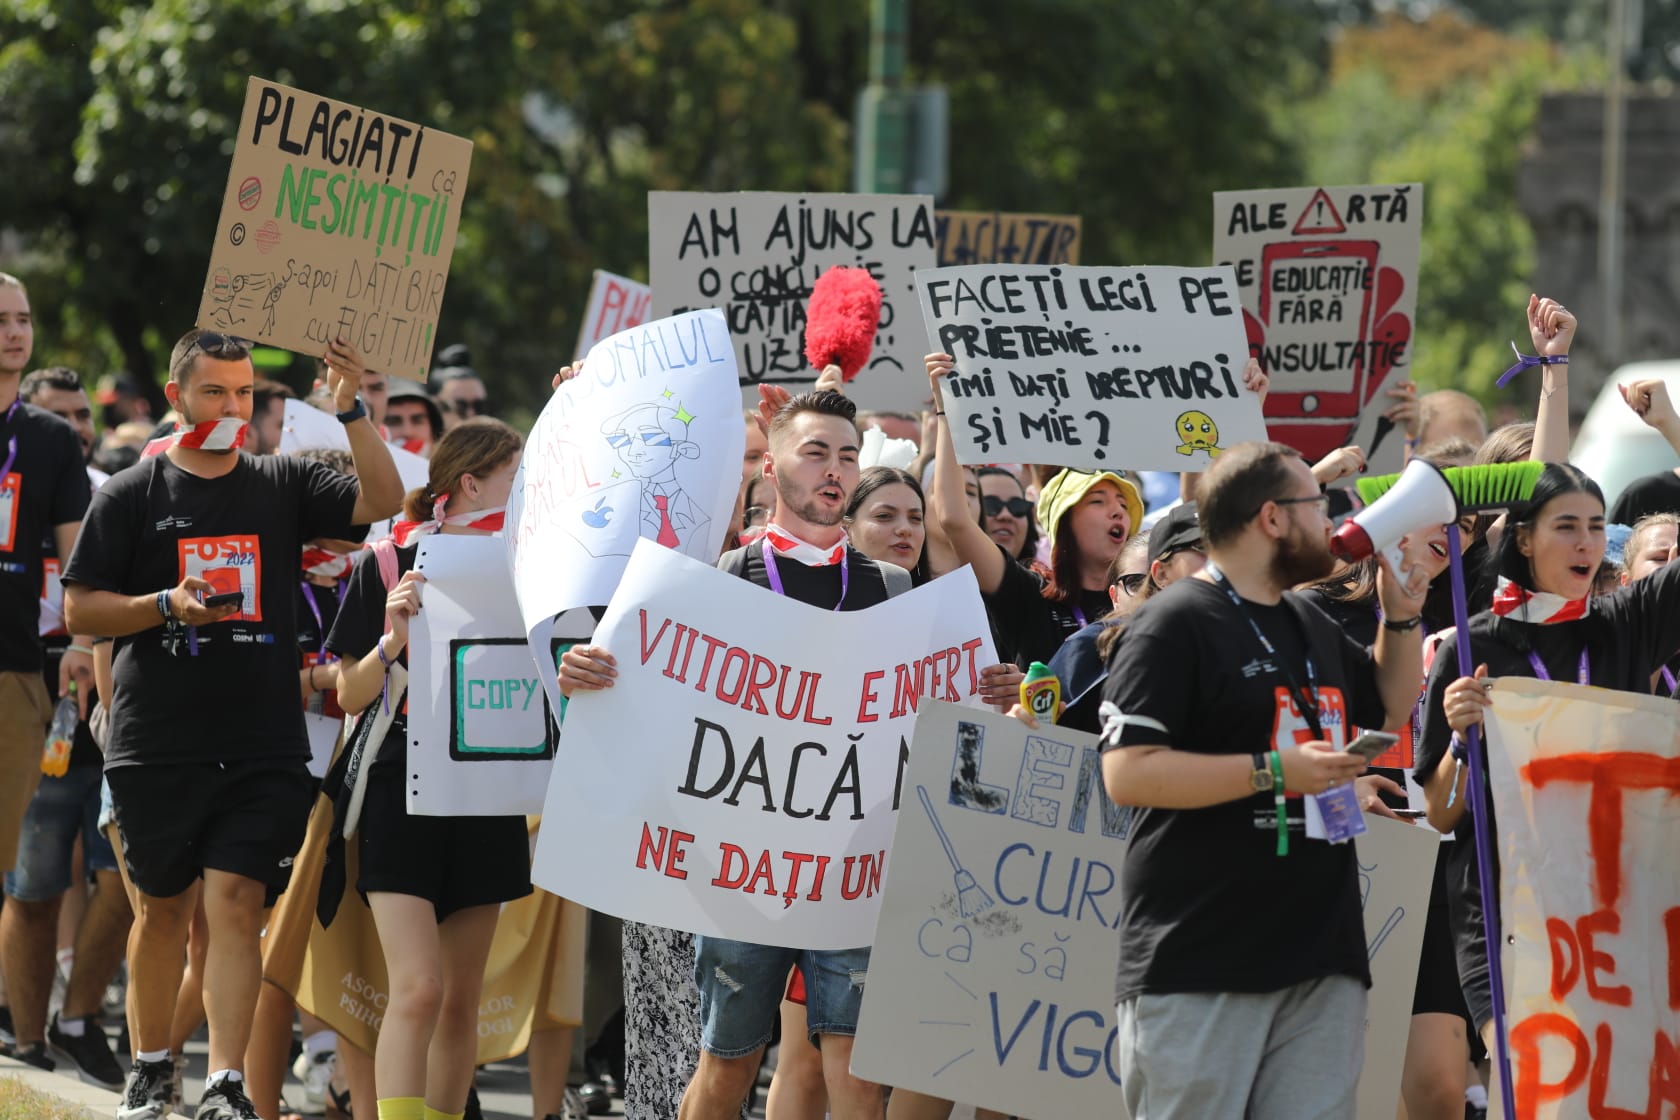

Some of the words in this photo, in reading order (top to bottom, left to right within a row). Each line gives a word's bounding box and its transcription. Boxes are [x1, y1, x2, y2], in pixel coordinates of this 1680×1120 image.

[252, 86, 424, 184] PLAGIAȚI
[431, 169, 457, 194] ca
[679, 205, 741, 260] AM
[892, 203, 934, 248] LA
[699, 267, 721, 298] O
[927, 267, 1068, 322] FACEȚI
[1079, 273, 1156, 312] LEGI
[1179, 276, 1232, 316] PE
[1218, 259, 1254, 287] E
[1272, 260, 1374, 297] EDUCAȚIE
[1279, 294, 1343, 324] FĂRĂ
[939, 317, 1099, 362] PRIETENIE
[947, 367, 995, 398] ÎMI
[1007, 367, 1071, 407] DAȚI
[1086, 353, 1239, 399] DREPTURI
[968, 406, 1007, 453] ȘI
[226, 551, 256, 566] 2022
[638, 609, 833, 726] VIITORUL
[857, 670, 885, 724] E
[467, 678, 538, 711] COPY
[1032, 690, 1054, 712] Cif
[677, 717, 865, 821] DACĂ
[636, 821, 695, 881] NE
[711, 842, 831, 909] DAȚI
[994, 842, 1122, 931] CUR
[1017, 931, 1071, 982] să
[1546, 909, 1632, 1007] DE
[340, 971, 388, 1010] ASOC
[478, 995, 516, 1017] LOR
